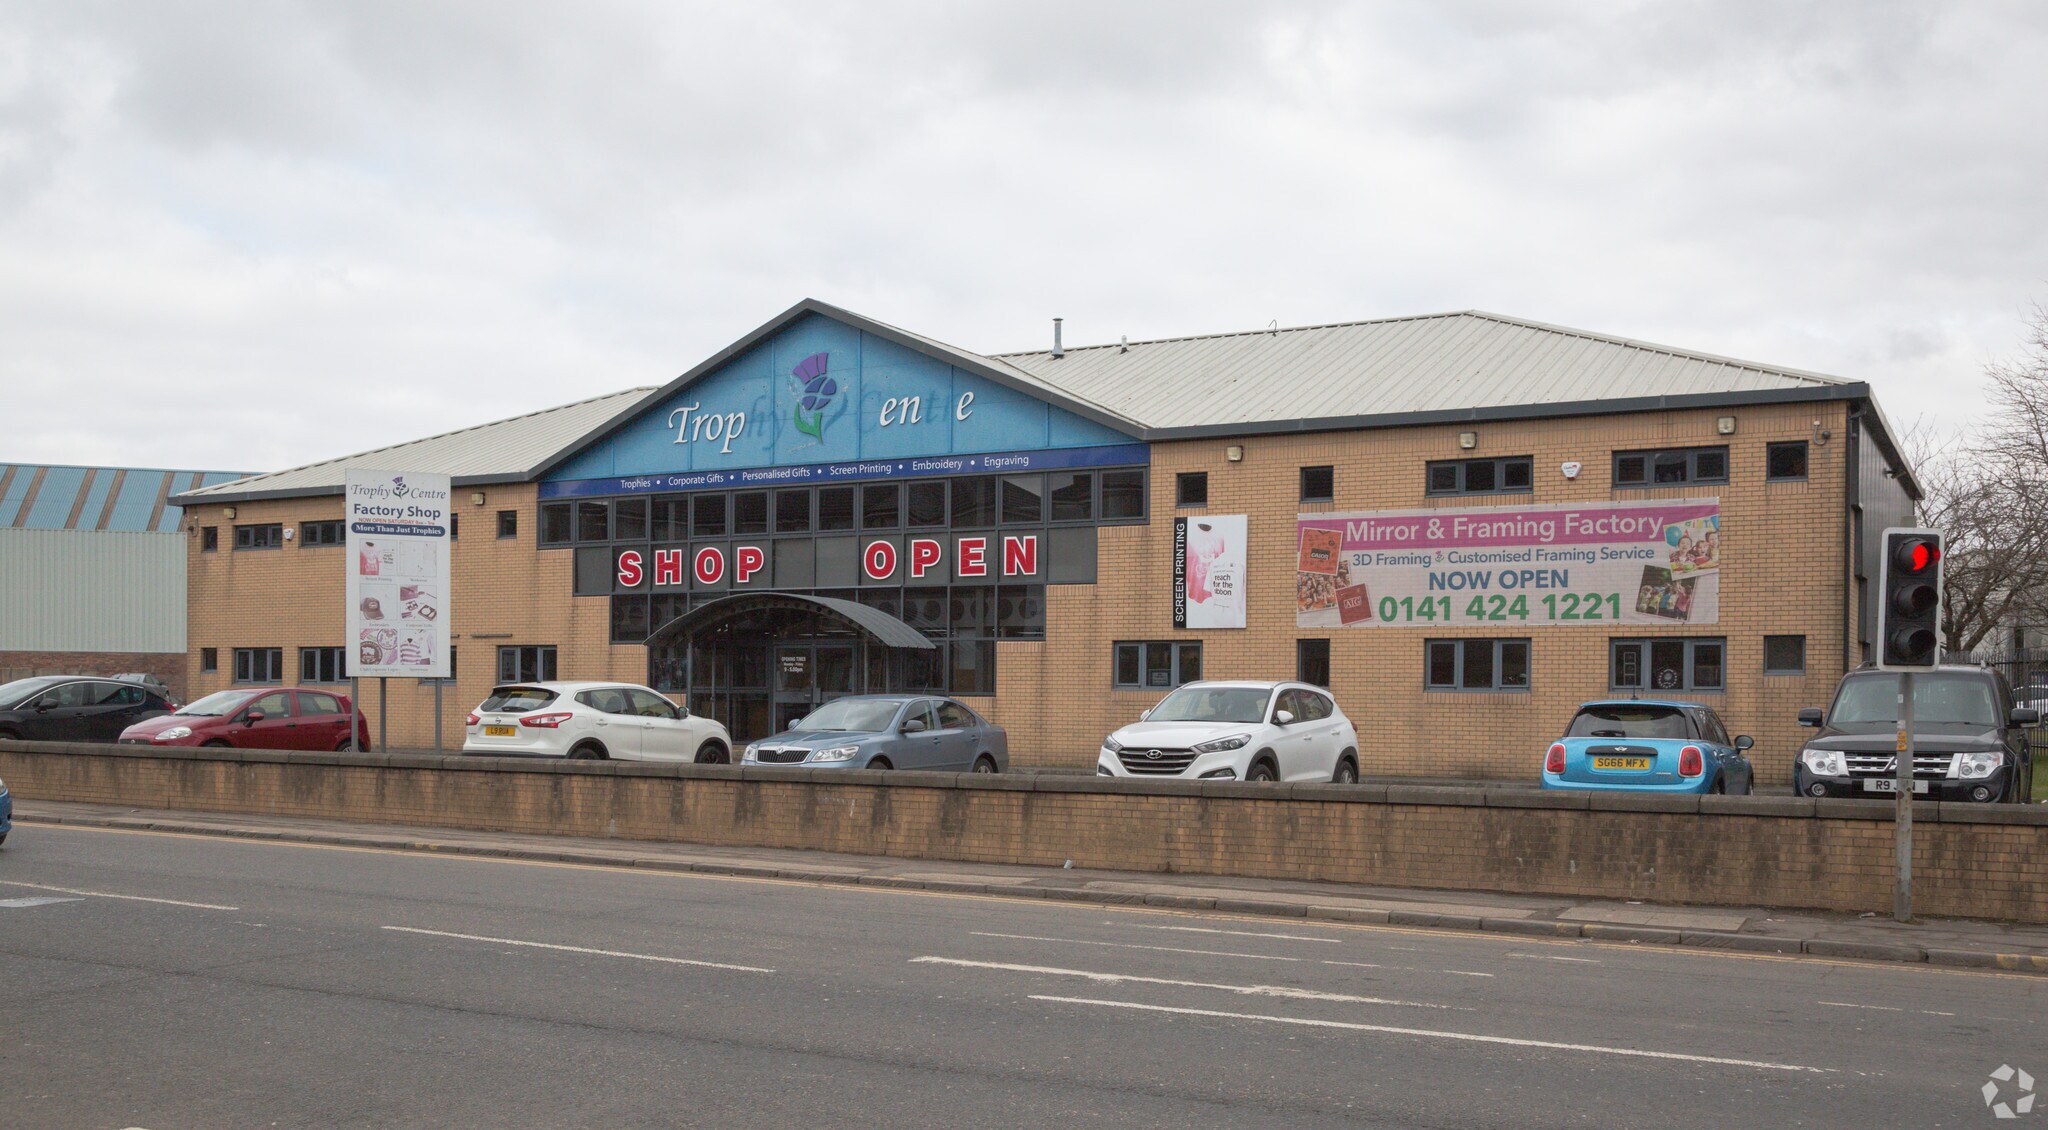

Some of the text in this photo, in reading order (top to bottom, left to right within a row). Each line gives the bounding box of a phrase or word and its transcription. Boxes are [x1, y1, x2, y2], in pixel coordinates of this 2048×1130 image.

[620, 455, 1029, 490] Trophies Corporate Gifts Personalised Gifts Screen Printing Embroidery Engraving
[350, 484, 446, 500] Trophy Centre
[354, 503, 441, 520] Factory Shop
[377, 524, 395, 532] Than
[411, 526, 441, 535] Trophies
[1346, 520, 1419, 542] Mirror
[1426, 518, 1445, 540] &
[1454, 515, 1555, 542] Framing
[1565, 513, 1664, 539] Factory
[618, 535, 1037, 587] SHOP OPEN
[1352, 547, 1655, 567] 3D Framing Customised Framing Service
[1175, 523, 1185, 622] SCREEN PRINTING
[1429, 569, 1568, 590] NOW OPEN
[1222, 581, 1233, 589] the
[1379, 593, 1620, 622] 0141 424 1221
[1597, 758, 1645, 768] SG66 MFX
[1876, 780, 1890, 790] R9
